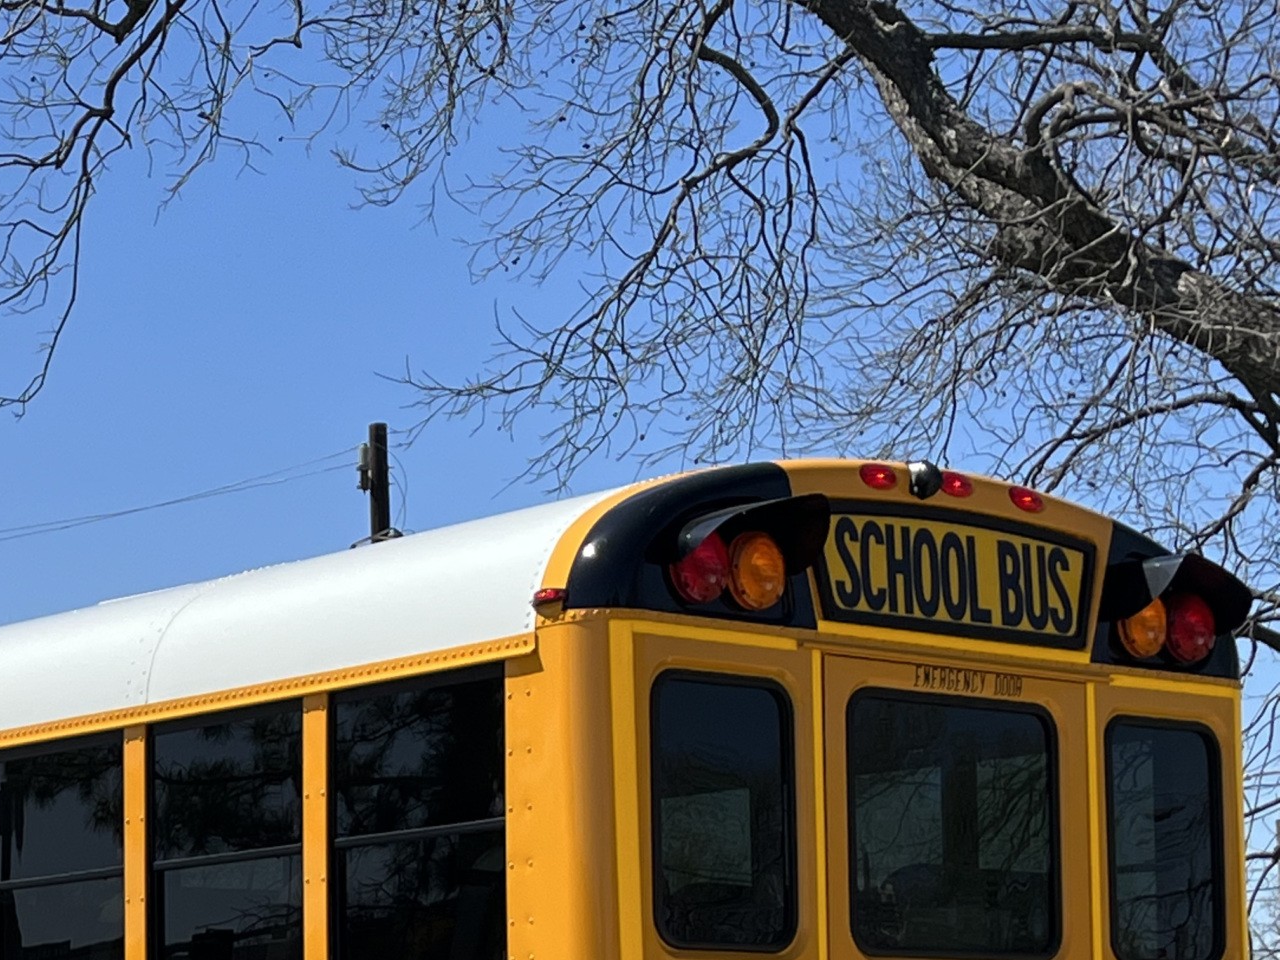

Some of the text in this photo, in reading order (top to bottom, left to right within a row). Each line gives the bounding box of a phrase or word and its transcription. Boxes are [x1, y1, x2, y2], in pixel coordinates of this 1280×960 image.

[834, 516, 1073, 635] SCHOOL BUS
[913, 663, 985, 694] EMERGENCY
